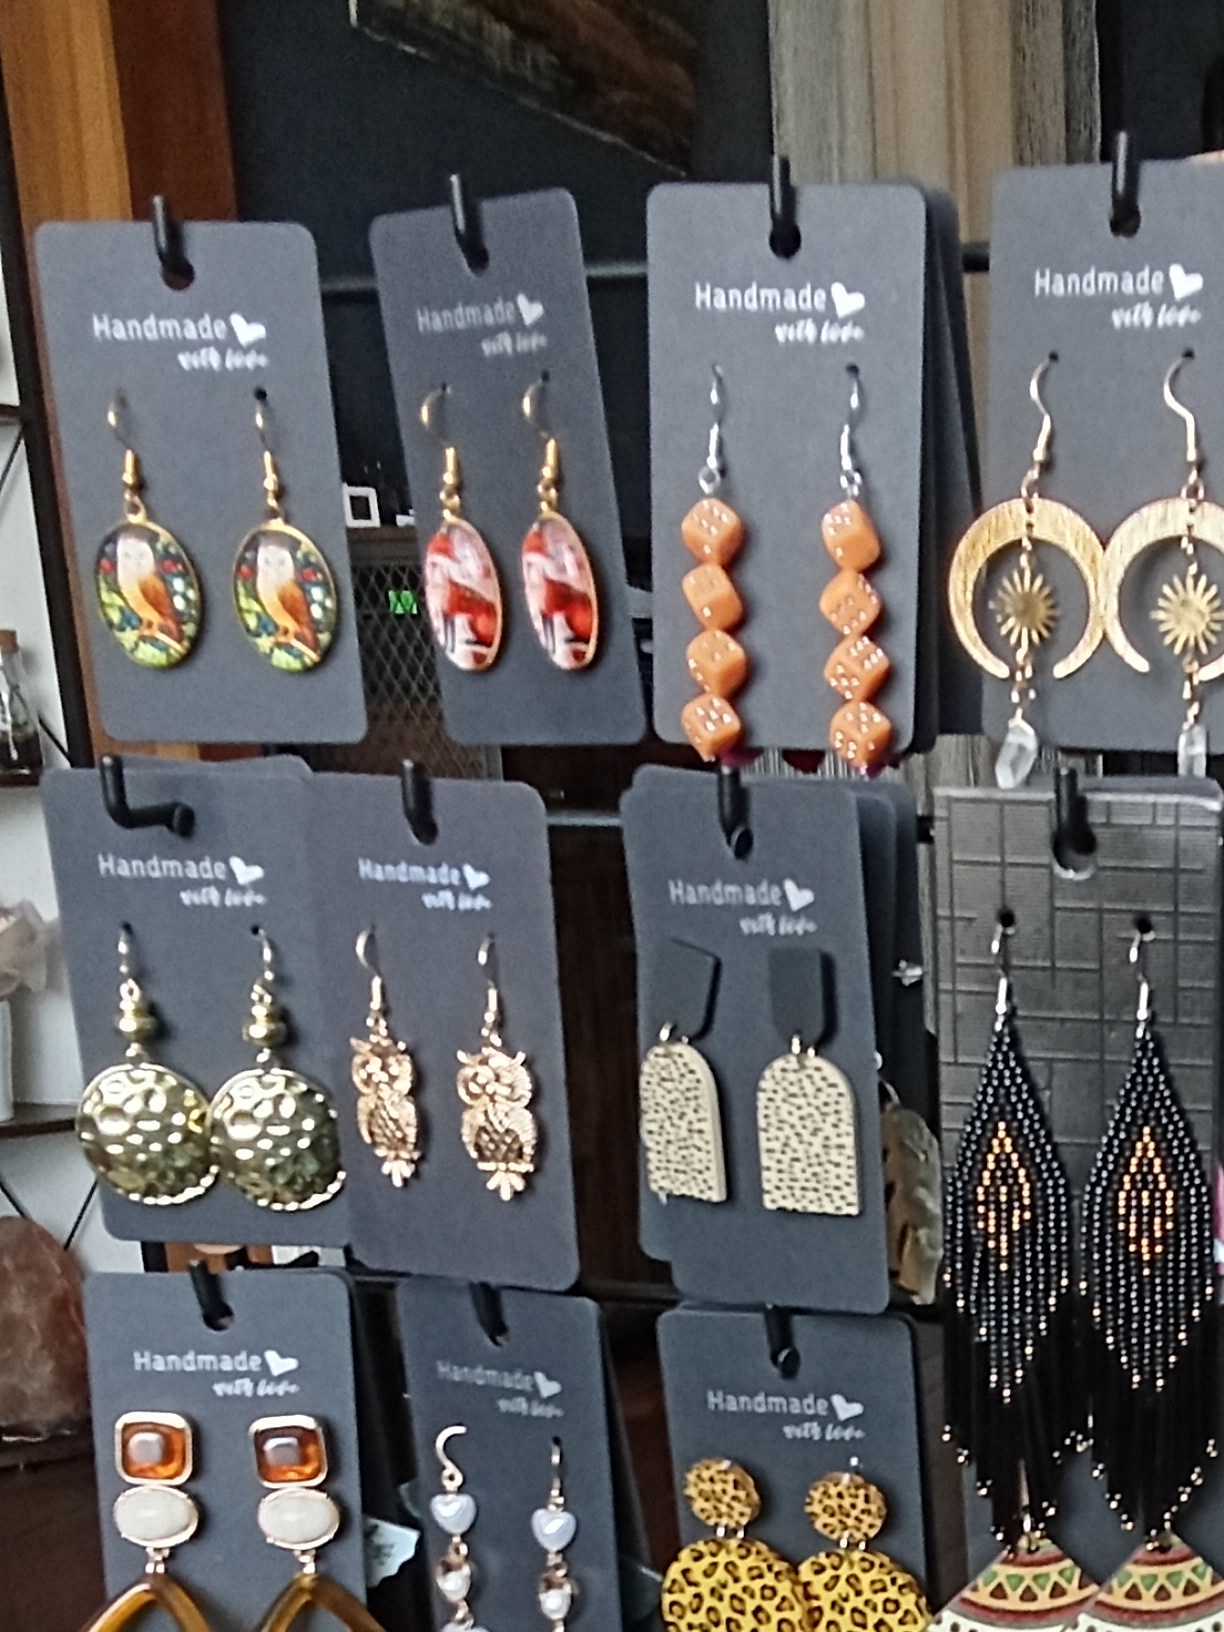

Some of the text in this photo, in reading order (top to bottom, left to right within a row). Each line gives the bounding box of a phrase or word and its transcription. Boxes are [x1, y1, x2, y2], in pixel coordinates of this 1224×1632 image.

[1034, 265, 1164, 297] Handmade
[695, 282, 827, 312] Handmade
[93, 313, 227, 341] Handmade
[417, 296, 516, 333] Handmade
[98, 854, 226, 880] Handmade
[358, 858, 460, 886] Handmade
[669, 879, 781, 906] Handmade
[133, 1350, 262, 1372] Handmade
[437, 1360, 533, 1392] Handmade
[707, 1390, 828, 1416] Handmade
